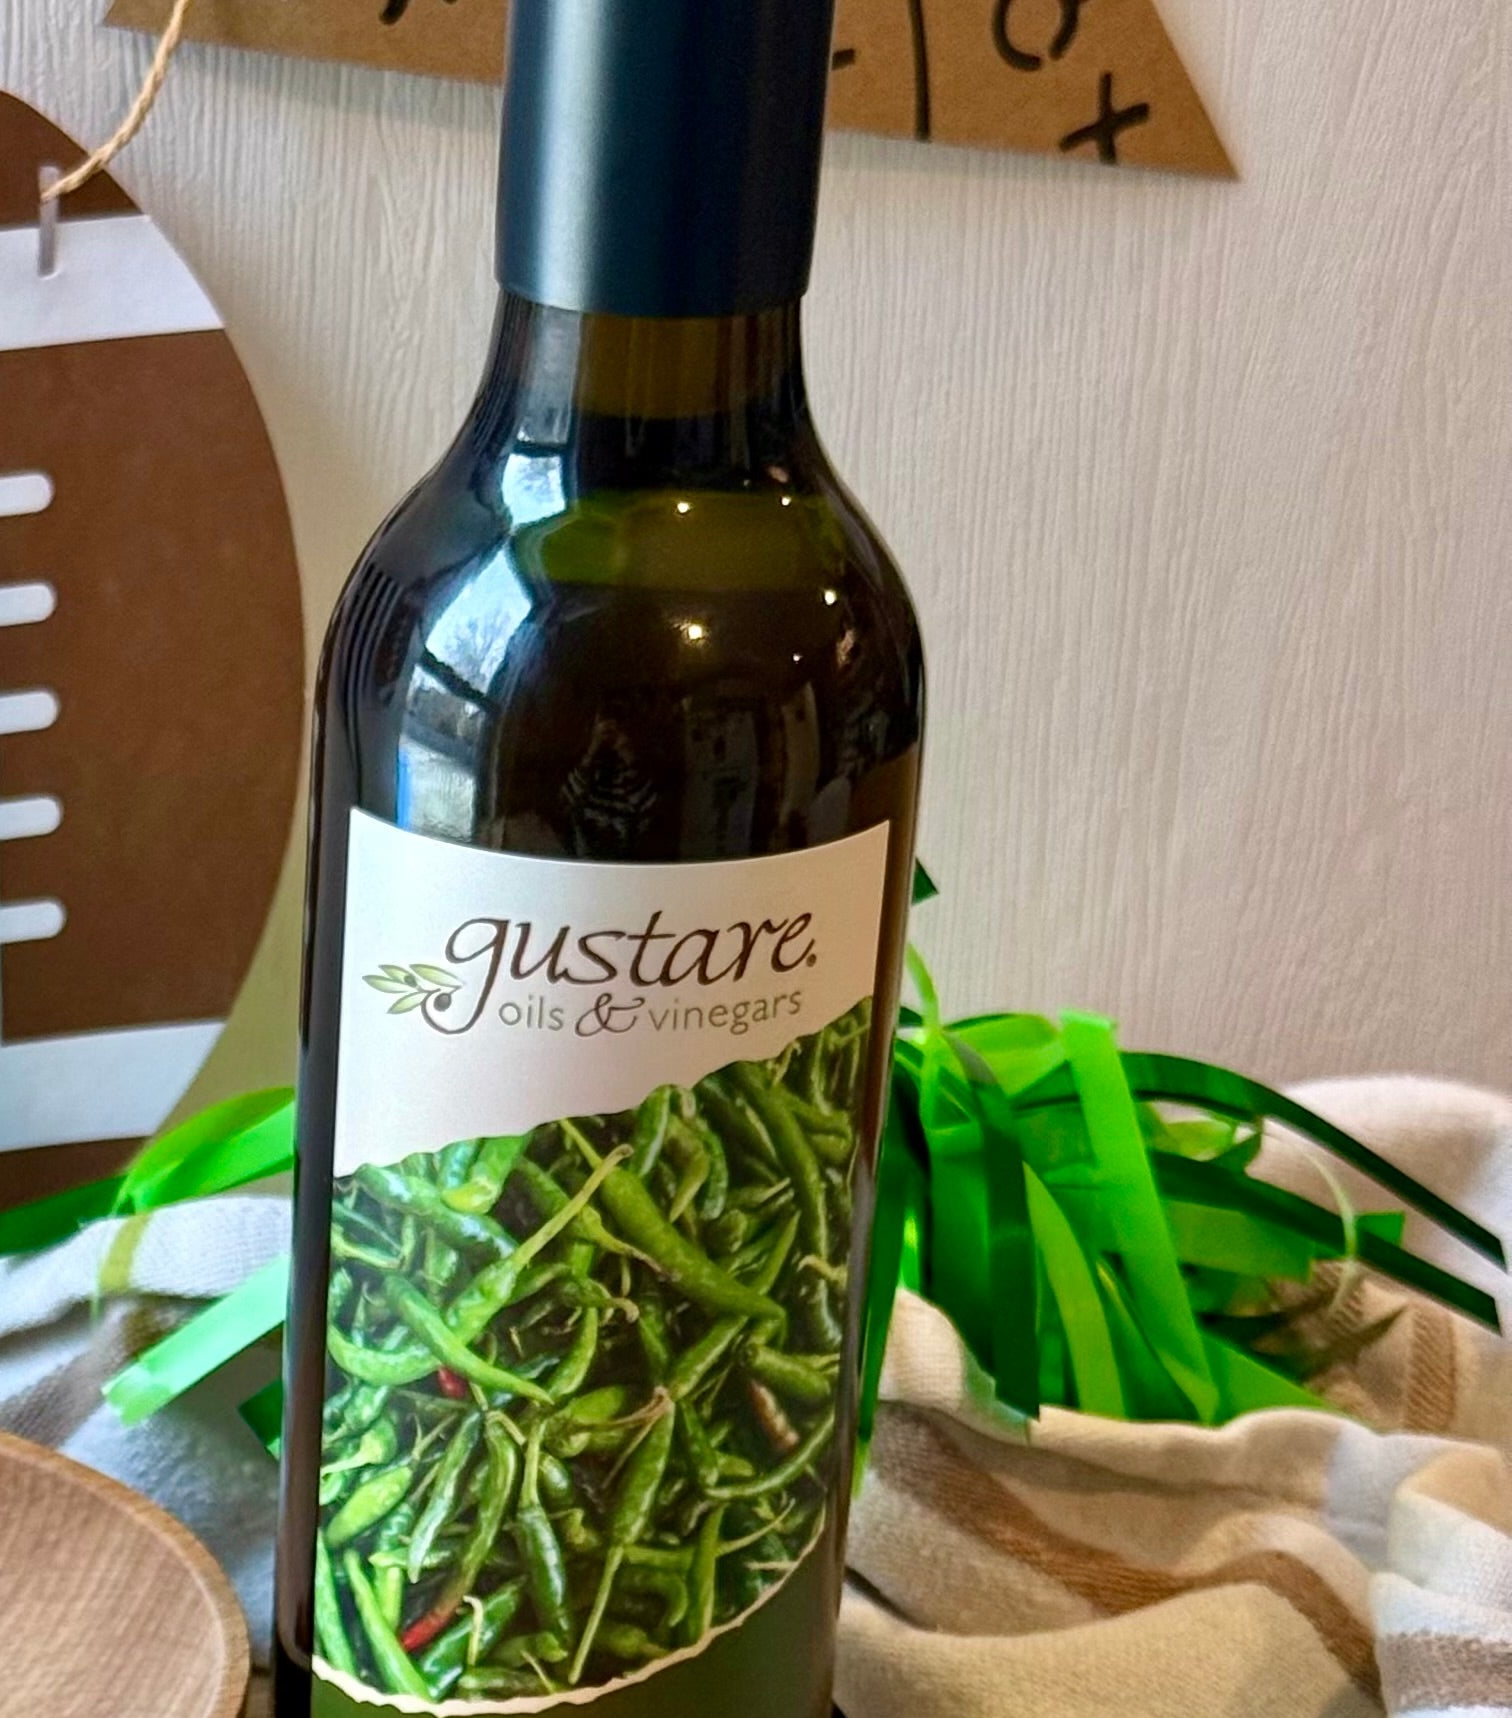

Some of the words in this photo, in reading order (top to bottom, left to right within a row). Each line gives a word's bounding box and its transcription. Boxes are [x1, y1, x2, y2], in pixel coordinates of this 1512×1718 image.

[498, 994, 564, 1031] oils
[574, 991, 645, 1037] &
[647, 989, 803, 1035] vinegars
